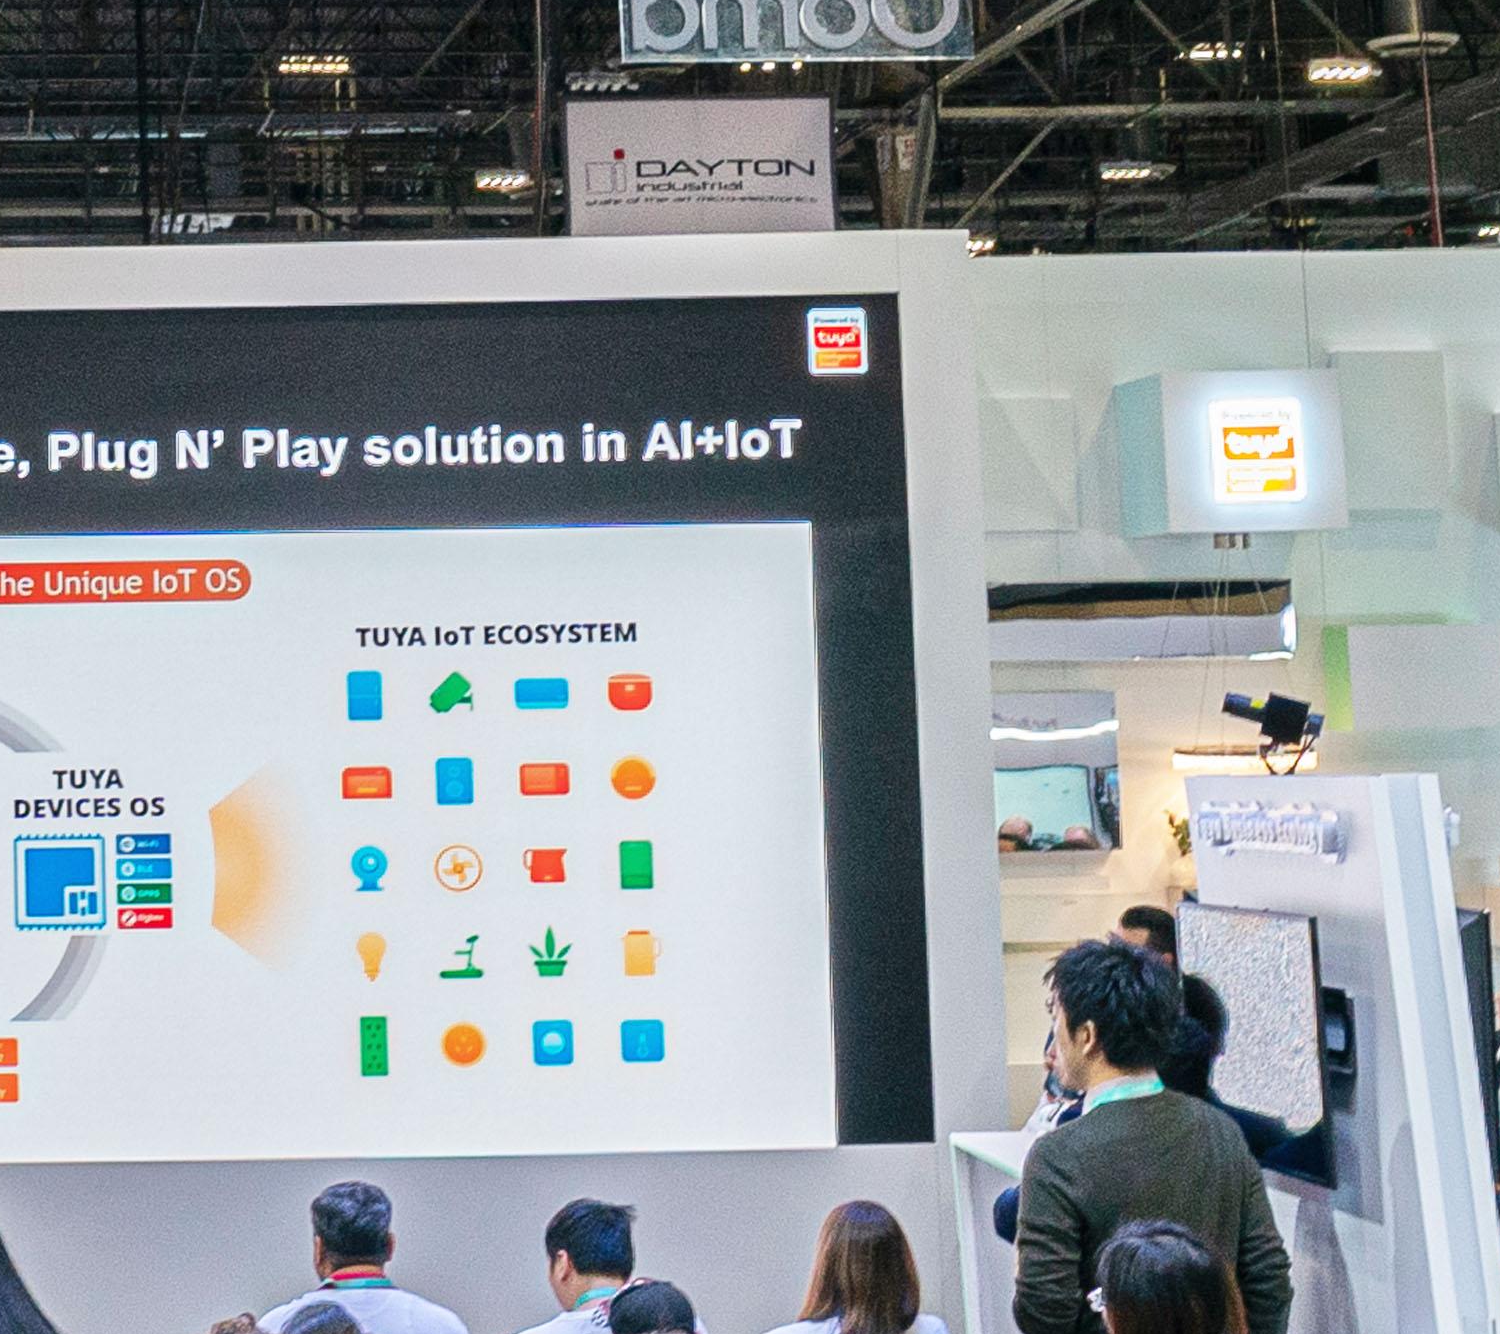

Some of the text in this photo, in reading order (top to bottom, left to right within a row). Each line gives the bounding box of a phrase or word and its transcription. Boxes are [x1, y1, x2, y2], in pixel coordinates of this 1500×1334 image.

[636, 158, 815, 178] DAYTON
[818, 331, 855, 347] tuya
[47, 430, 158, 480] Plug
[243, 428, 348, 477] Play
[364, 423, 563, 468] solution
[583, 423, 627, 462] in
[642, 418, 803, 461] AI+IoT
[44, 570, 143, 601] Unique
[152, 569, 196, 595] IoT
[204, 568, 242, 594] OS
[355, 622, 637, 648] TUYA IoT ECOSYSTEM
[53, 769, 123, 790] TUYA
[13, 798, 165, 819] DEVICES OS
